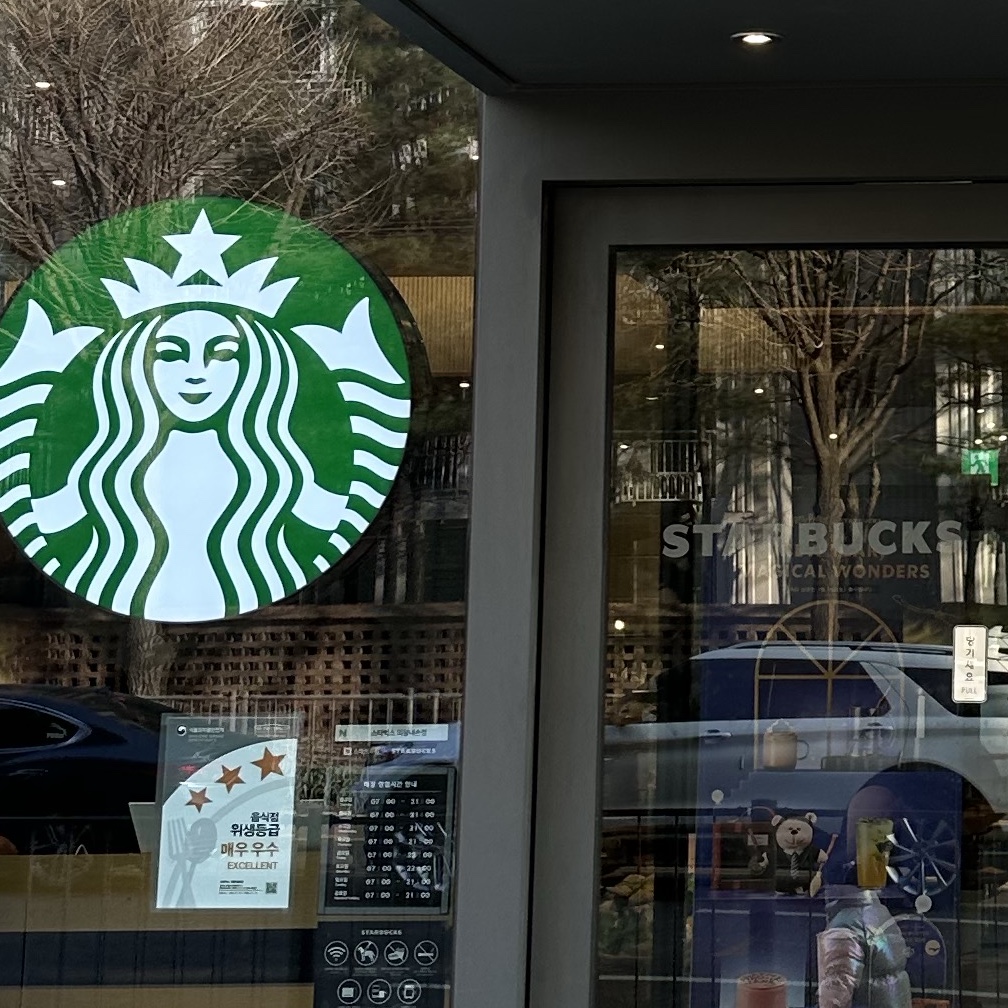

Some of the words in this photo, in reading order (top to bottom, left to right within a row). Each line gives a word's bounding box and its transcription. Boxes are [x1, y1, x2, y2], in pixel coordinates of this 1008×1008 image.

[961, 686, 977, 695] PULL
[250, 812, 279, 823] 음식점
[230, 823, 280, 837] 위생등급
[228, 861, 278, 870] EXCELLENT
